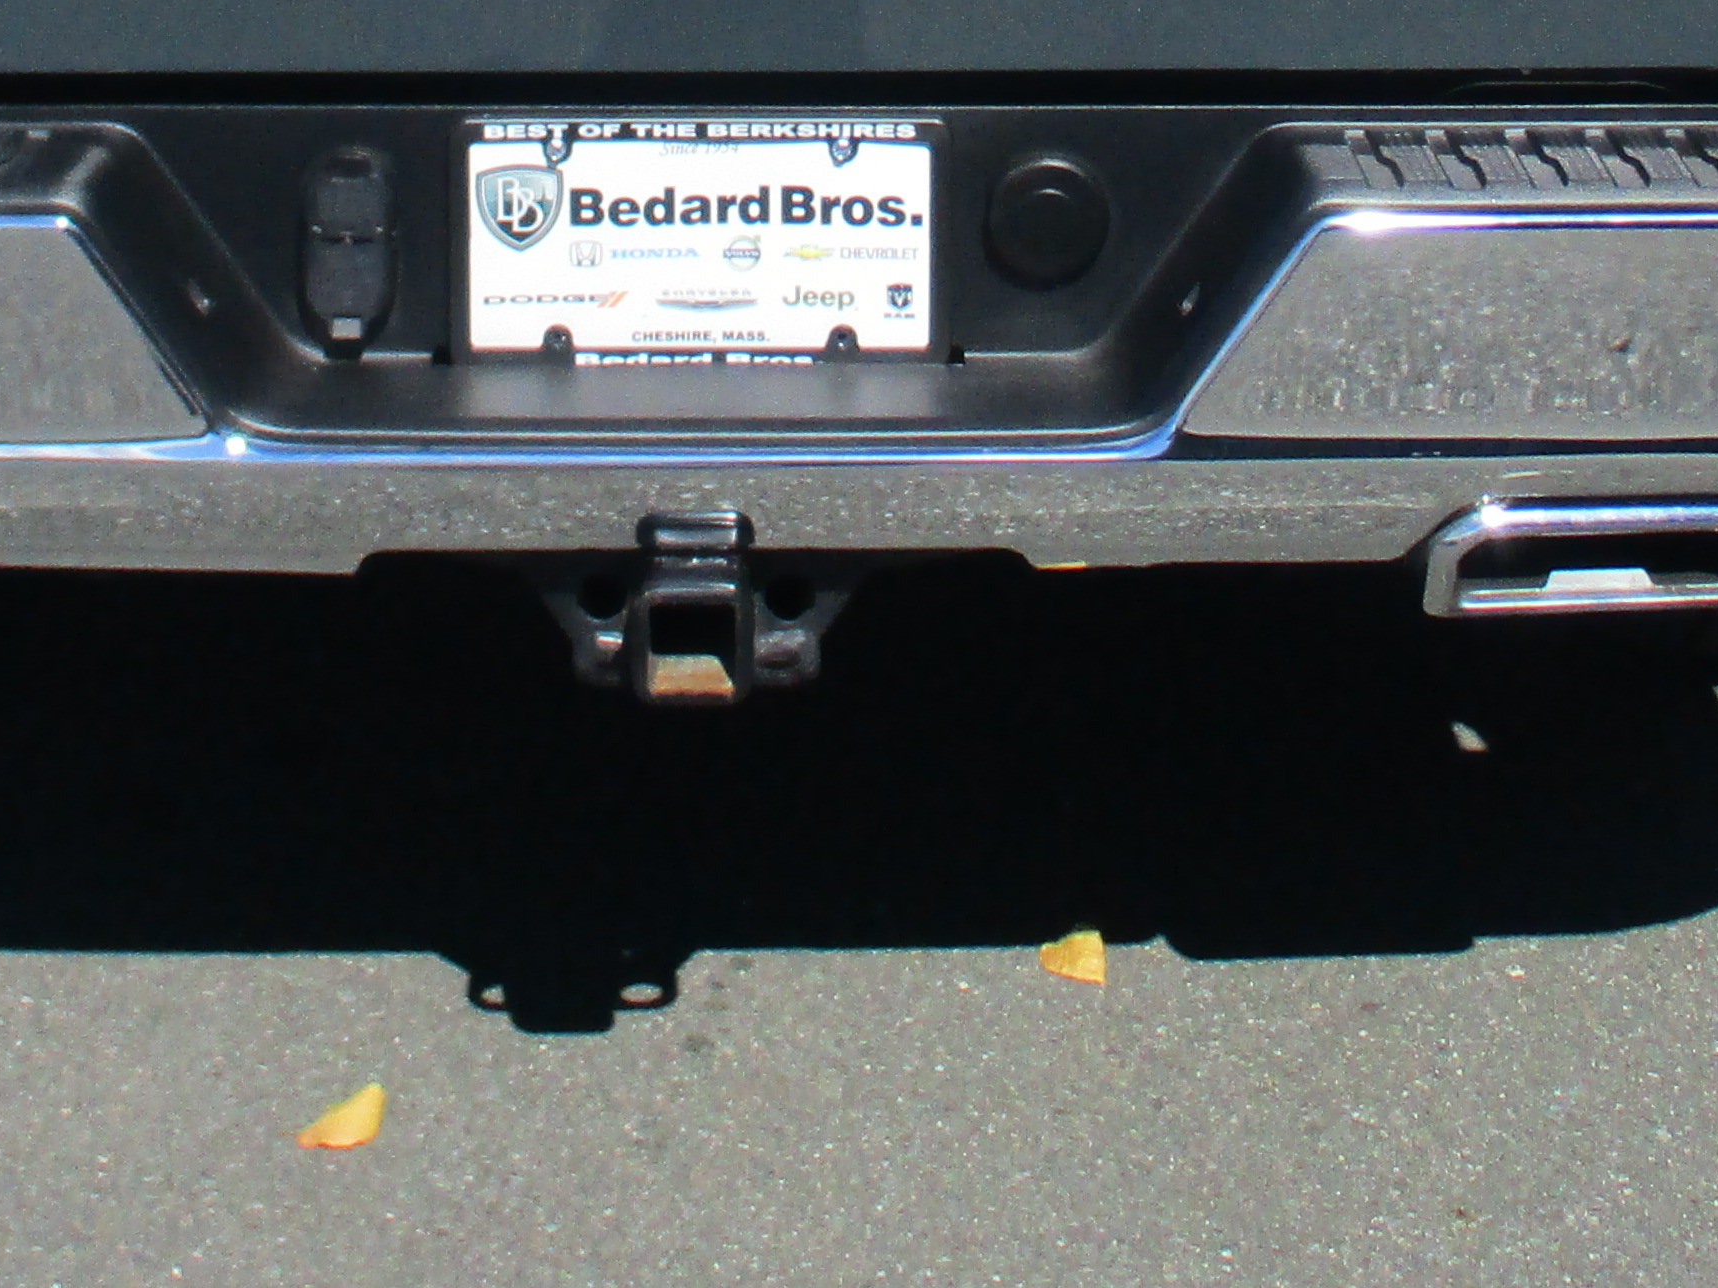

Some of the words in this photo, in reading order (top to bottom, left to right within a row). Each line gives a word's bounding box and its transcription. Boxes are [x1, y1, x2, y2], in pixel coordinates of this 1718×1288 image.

[483, 123, 570, 140] BEST
[577, 123, 622, 139] OF
[629, 123, 698, 139] THE
[706, 123, 917, 140] BERKSHIRES
[569, 185, 771, 227] Bedard
[780, 184, 924, 227] Bros.
[610, 247, 701, 260] HONDA
[840, 246, 920, 260] CHEVROLET
[483, 293, 609, 305] DODGE
[782, 285, 856, 312] Jeep
[632, 330, 718, 344] CHESHIRE,
[721, 330, 772, 343] MASS.
